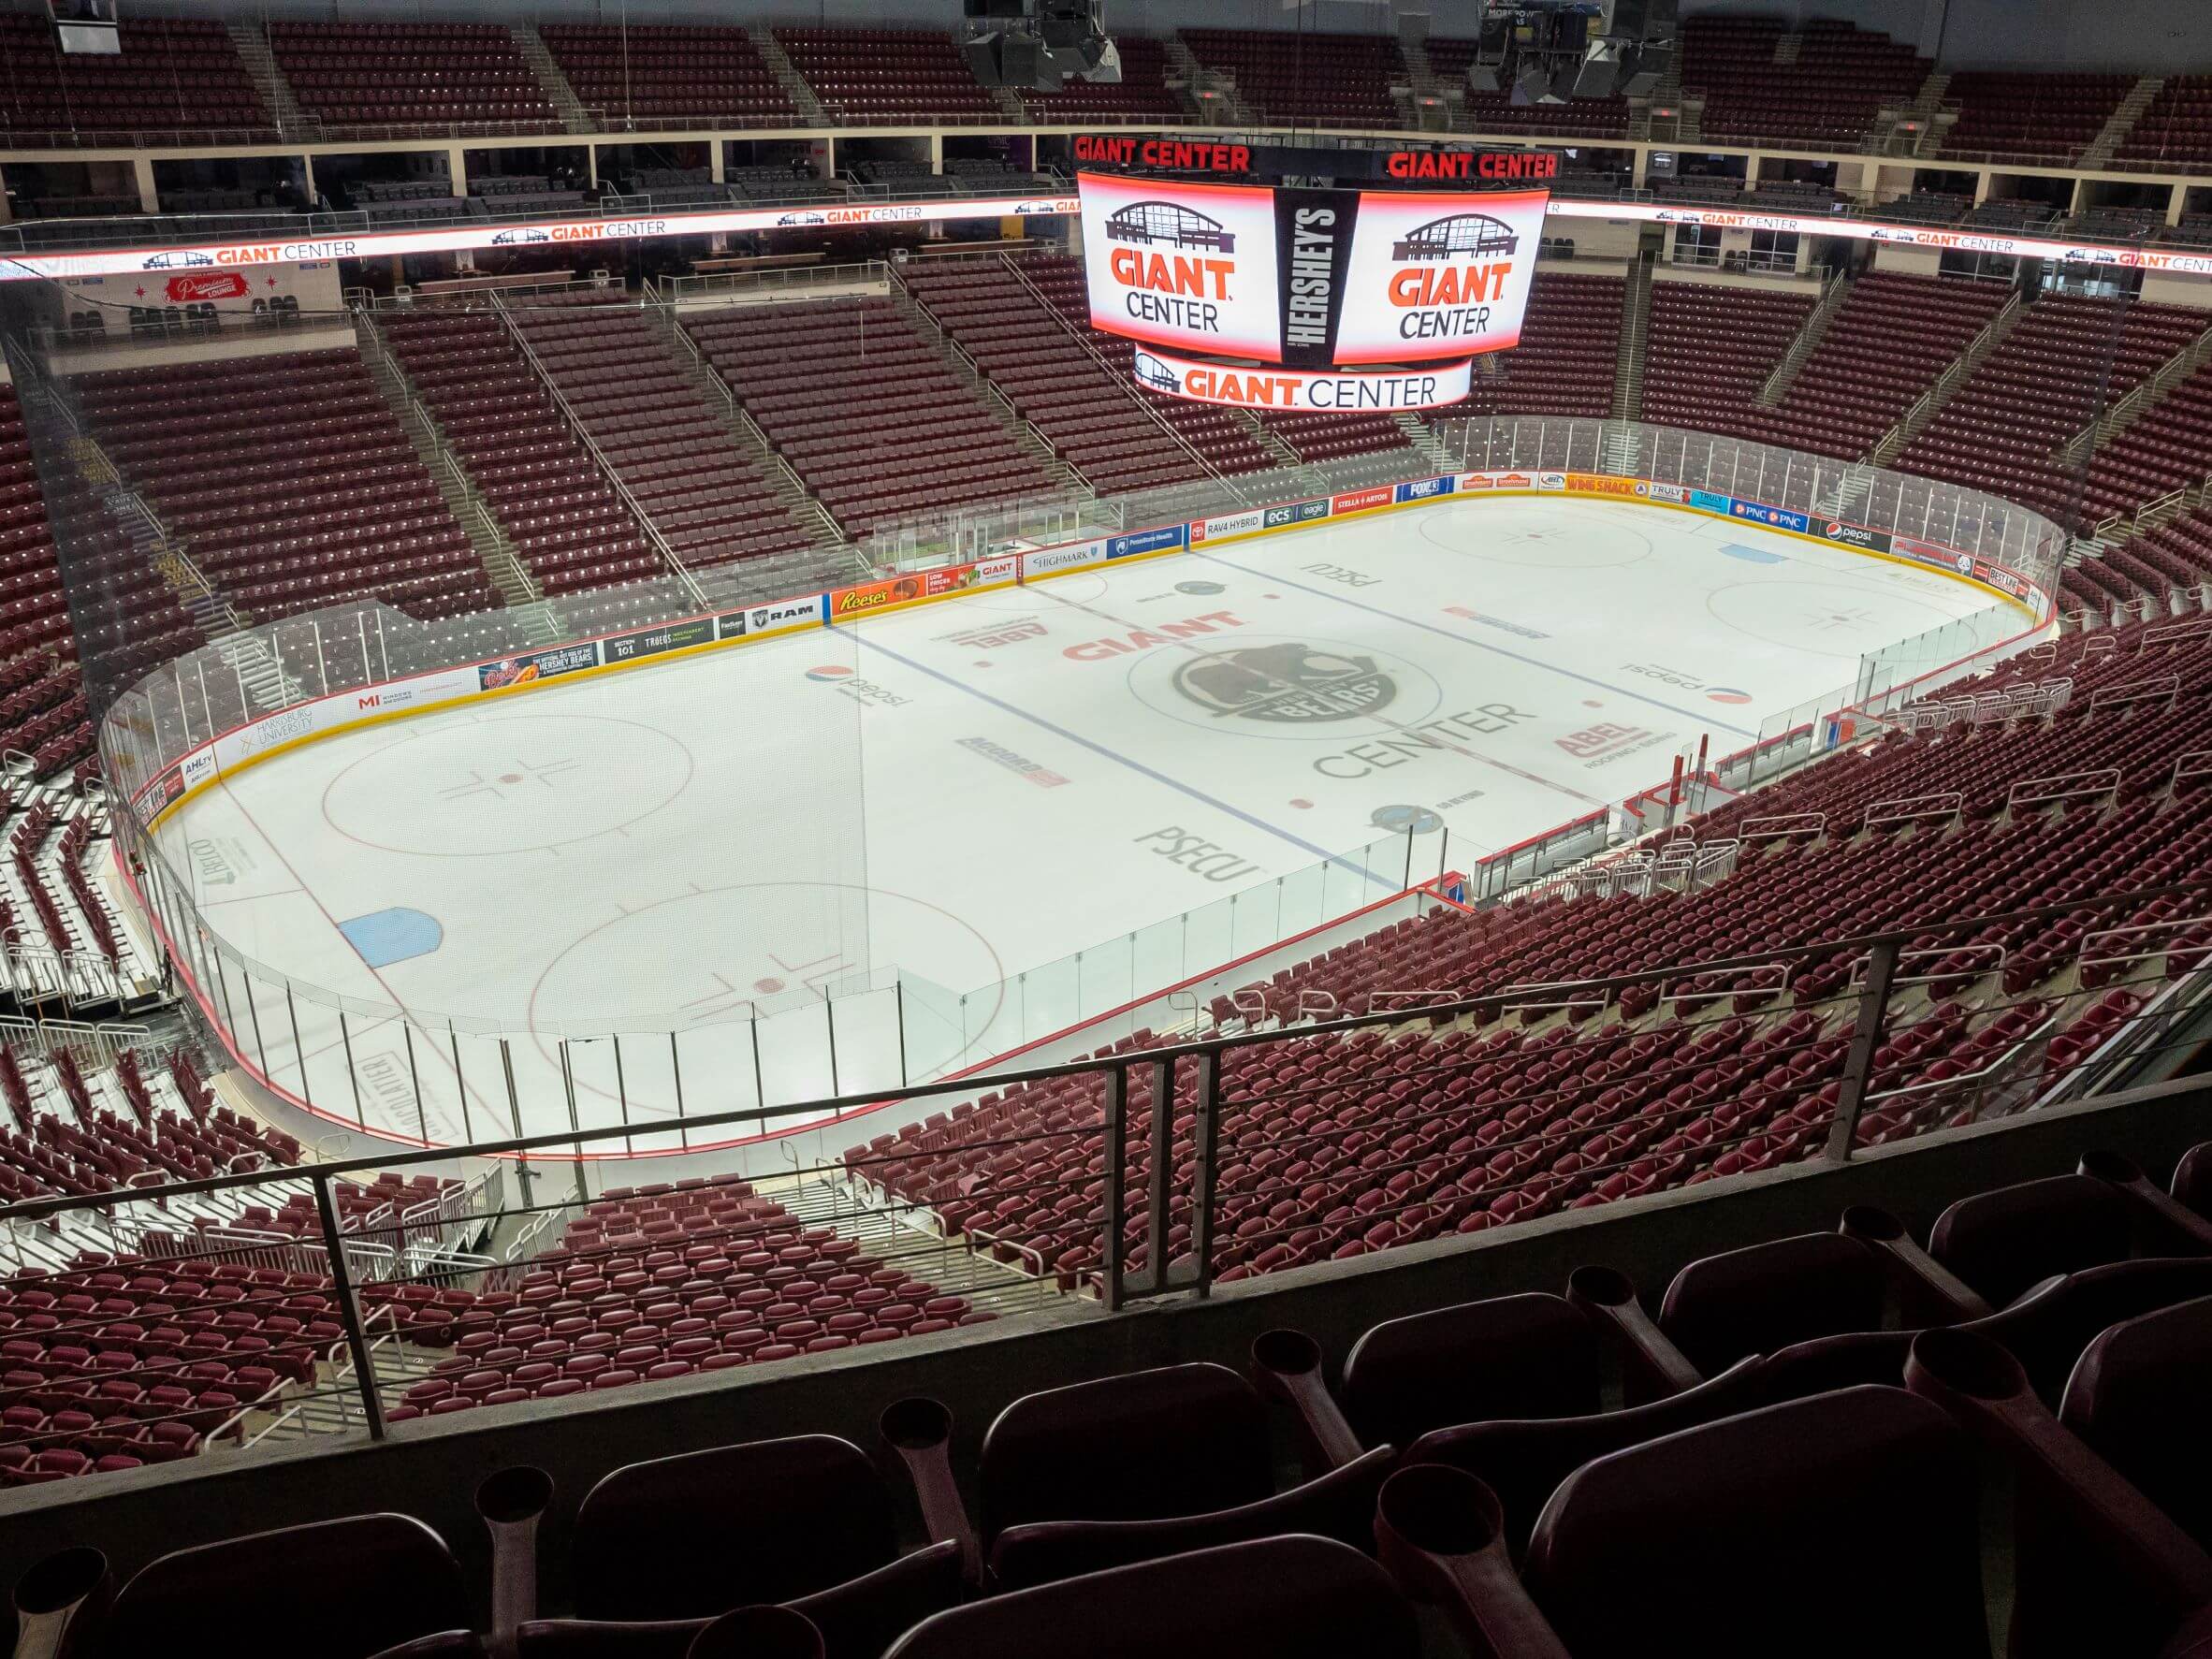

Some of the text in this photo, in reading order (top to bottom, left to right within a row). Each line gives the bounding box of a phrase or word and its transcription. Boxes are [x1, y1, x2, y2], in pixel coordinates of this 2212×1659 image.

[1076, 135, 1250, 173] GIANT CENTER
[1388, 152, 1557, 179] GIANT CENTER
[828, 207, 922, 223] GIANT CENTER
[1702, 213, 1797, 231] GIANT CENTER
[551, 221, 665, 240] GIANT CENTER
[217, 247, 282, 265] GIANT
[285, 240, 357, 260] CENTER
[1917, 232, 2013, 254] GIANT CENTER
[2118, 253, 2171, 268] GIANT
[1111, 247, 1235, 301] GIANT
[1288, 207, 1336, 344] HERSHEY'S
[208, 284, 237, 298] LOUNGE
[1388, 263, 1511, 308] GIANT
[1127, 291, 1219, 333] CENTER
[1399, 307, 1490, 340] CENTER
[1186, 369, 1436, 409] GIANT CENTER
[1567, 478, 1633, 494] WING SHACK
[1652, 485, 1681, 498] TRULY
[1338, 493, 1388, 509] STELLA ARTOIS
[1700, 492, 1724, 502] TRULY
[1268, 509, 1288, 523] ecs
[1302, 503, 1324, 516] eagle
[1746, 507, 1767, 519] PNC
[1207, 517, 1259, 534] RAV4 HYBRID
[1780, 515, 1800, 528] PNC
[1843, 528, 1872, 542] pepsi
[982, 563, 1012, 575] GIANT
[1033, 550, 1087, 568] HIGHMARK
[1990, 568, 2005, 582] BEST
[770, 605, 814, 621] RAM
[1062, 609, 1243, 673] GIANT
[618, 646, 635, 657] 101
[539, 660, 570, 676] HERSHEY
[570, 654, 592, 668] BEARS
[1619, 662, 1707, 691] pepsi
[358, 694, 381, 709] MI
[839, 679, 914, 707] pepsi
[1269, 679, 1381, 719] BEARS
[255, 708, 313, 735] HARRISBURG
[259, 720, 313, 745] UNIVERSITY
[1312, 702, 1537, 782] CENTER
[1554, 722, 1640, 751] ABEL
[1583, 748, 1637, 770] ROOFING
[1132, 824, 1260, 881] PSECU
